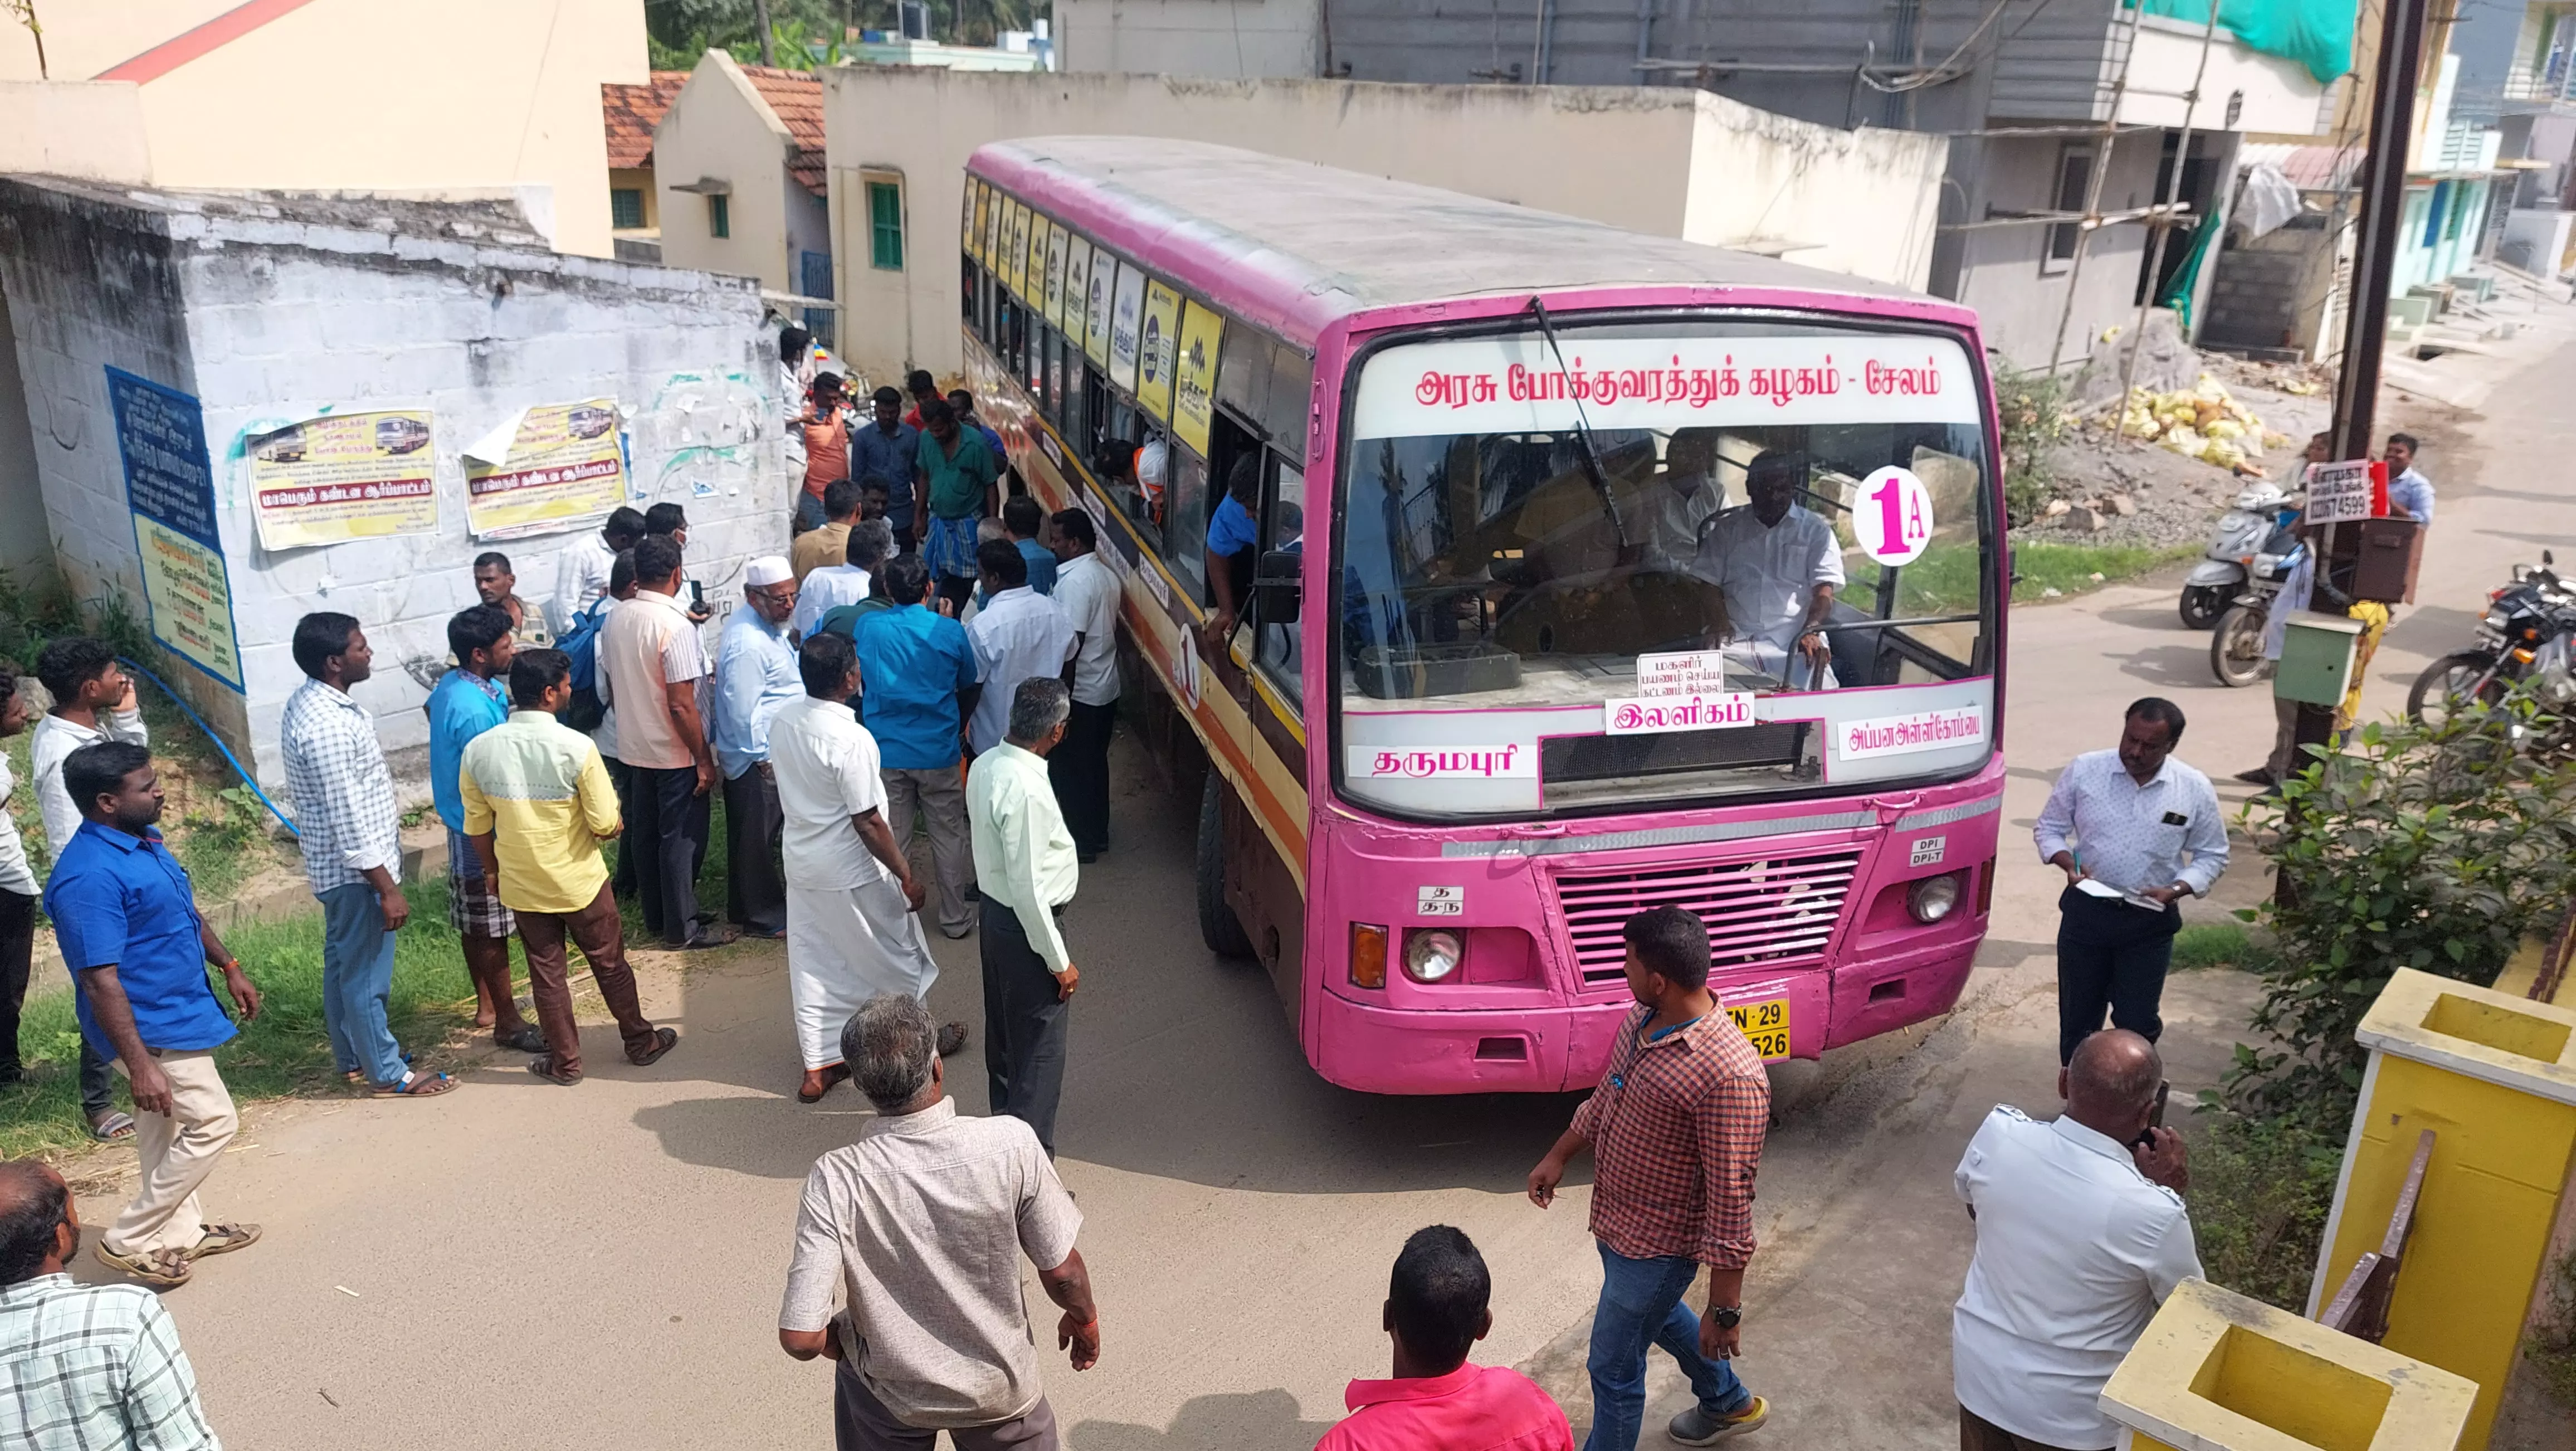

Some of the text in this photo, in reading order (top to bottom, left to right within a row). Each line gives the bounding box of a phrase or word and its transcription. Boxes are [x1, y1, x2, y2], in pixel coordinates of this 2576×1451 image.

[1416, 371, 1498, 410] அரசு
[1507, 354, 1740, 408] போக்குவரத்துக்
[1749, 354, 1841, 407] கழகம்
[1865, 355, 1941, 395] சேலம்
[262, 478, 431, 506] மாபெரும் கண்டன ஆர்ப்பாட்டம்
[1655, 655, 1702, 671] மகளிர்
[1642, 668, 1720, 684] பயணம் செய்ய
[1642, 682, 1720, 697] கட்டணம் இல்லை
[1614, 694, 1750, 729] இலளிகம்
[1371, 743, 1518, 778] தருமபுரி
[1920, 839, 1938, 850] DPI
[1913, 851, 1942, 864] DPI-T
[1432, 887, 1450, 899] த
